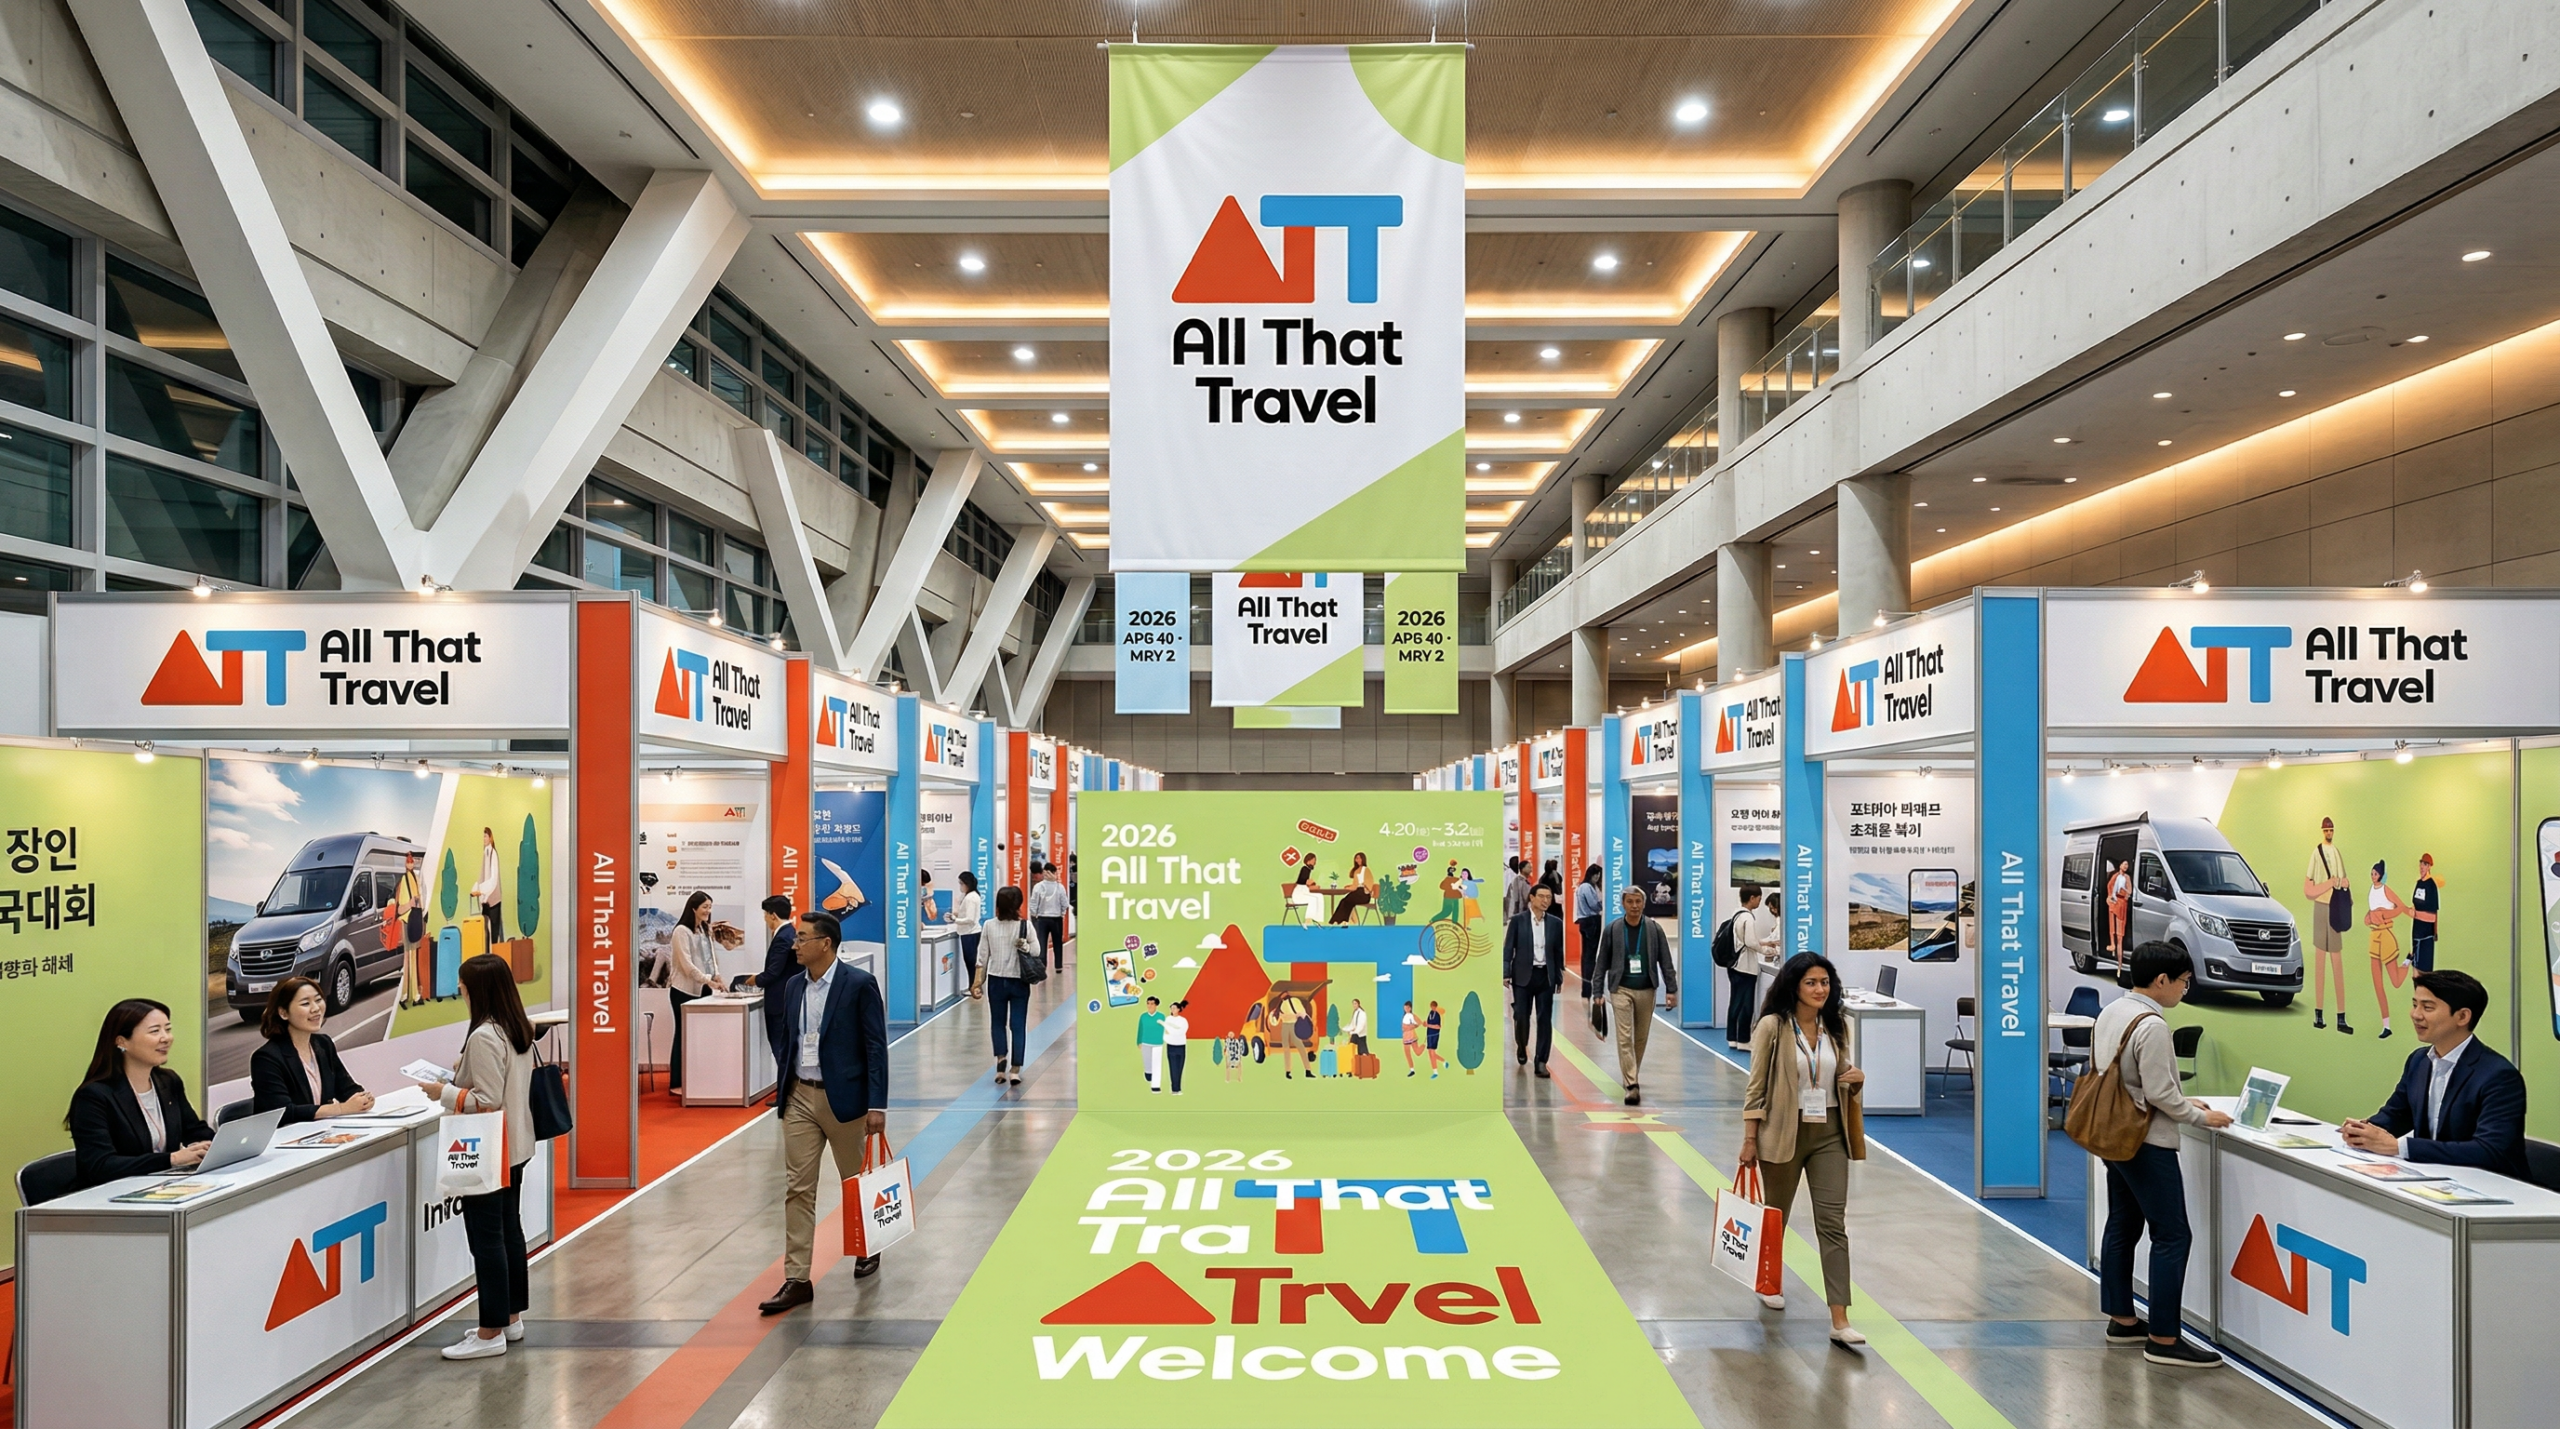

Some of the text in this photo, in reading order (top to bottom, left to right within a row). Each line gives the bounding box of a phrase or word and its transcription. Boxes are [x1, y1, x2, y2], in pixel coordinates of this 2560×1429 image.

[1172, 317, 1403, 366] All That
[1195, 375, 1377, 425] Travel
[1128, 610, 1177, 626] 2026
[1238, 596, 1338, 618] All That
[1397, 610, 1446, 626] 2026
[320, 628, 482, 664] All That
[1156, 632, 1175, 645] 40
[1247, 623, 1328, 645] Travel
[1425, 632, 1444, 645] 40
[2305, 626, 2468, 661] All That
[1130, 649, 1176, 662] MRY 2
[1399, 649, 1445, 662] MRY 2
[1884, 644, 1944, 685] All That
[319, 671, 449, 707] Travel
[712, 659, 760, 699] All That
[2305, 668, 2435, 704] Travel
[712, 695, 751, 731] Travel
[1884, 683, 1932, 722] Travel
[6, 827, 78, 874] 장인
[1100, 823, 1177, 848] 2026
[783, 845, 798, 868] All
[1100, 854, 1147, 885] All
[1157, 854, 1242, 885] That
[896, 841, 910, 939] All That Travel
[1100, 890, 1211, 921] Travel
[1691, 841, 1705, 938] All That Travel
[1797, 871, 1813, 912] That
[593, 852, 616, 1034] All That Travel
[1797, 914, 1813, 953] Trav
[2000, 850, 2026, 1038] All That Travel
[0, 956, 39, 980] 향화
[1106, 1149, 1293, 1171] 2026
[1085, 1177, 1494, 1210] All That
[1077, 1216, 1251, 1255] Tra
[1032, 1335, 1562, 1381] Welcome
